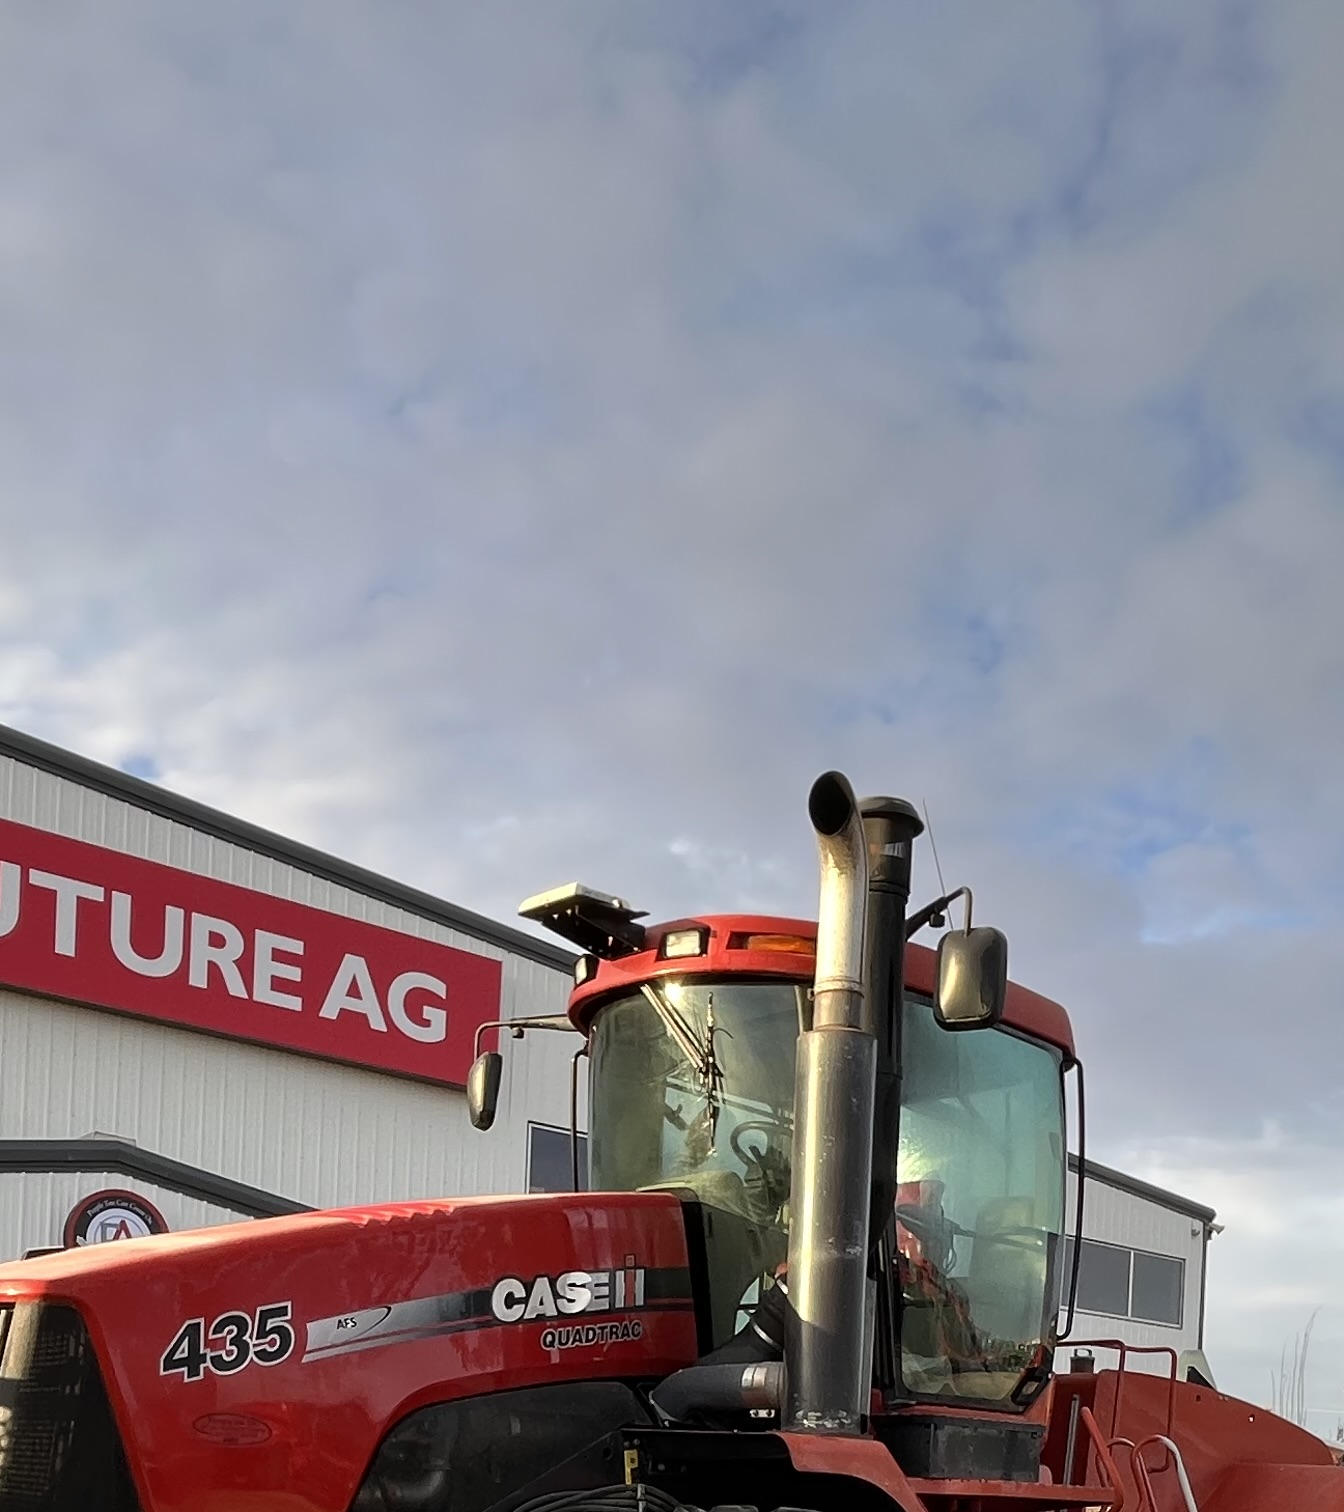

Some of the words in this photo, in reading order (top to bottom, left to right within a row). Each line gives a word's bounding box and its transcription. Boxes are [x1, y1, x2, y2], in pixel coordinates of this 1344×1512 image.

[318, 953, 449, 1044] AG
[492, 1271, 610, 1322] CASE
[160, 1300, 296, 1383] 435
[336, 1317, 357, 1330] AFS
[541, 1319, 643, 1351] QUADTRAC
